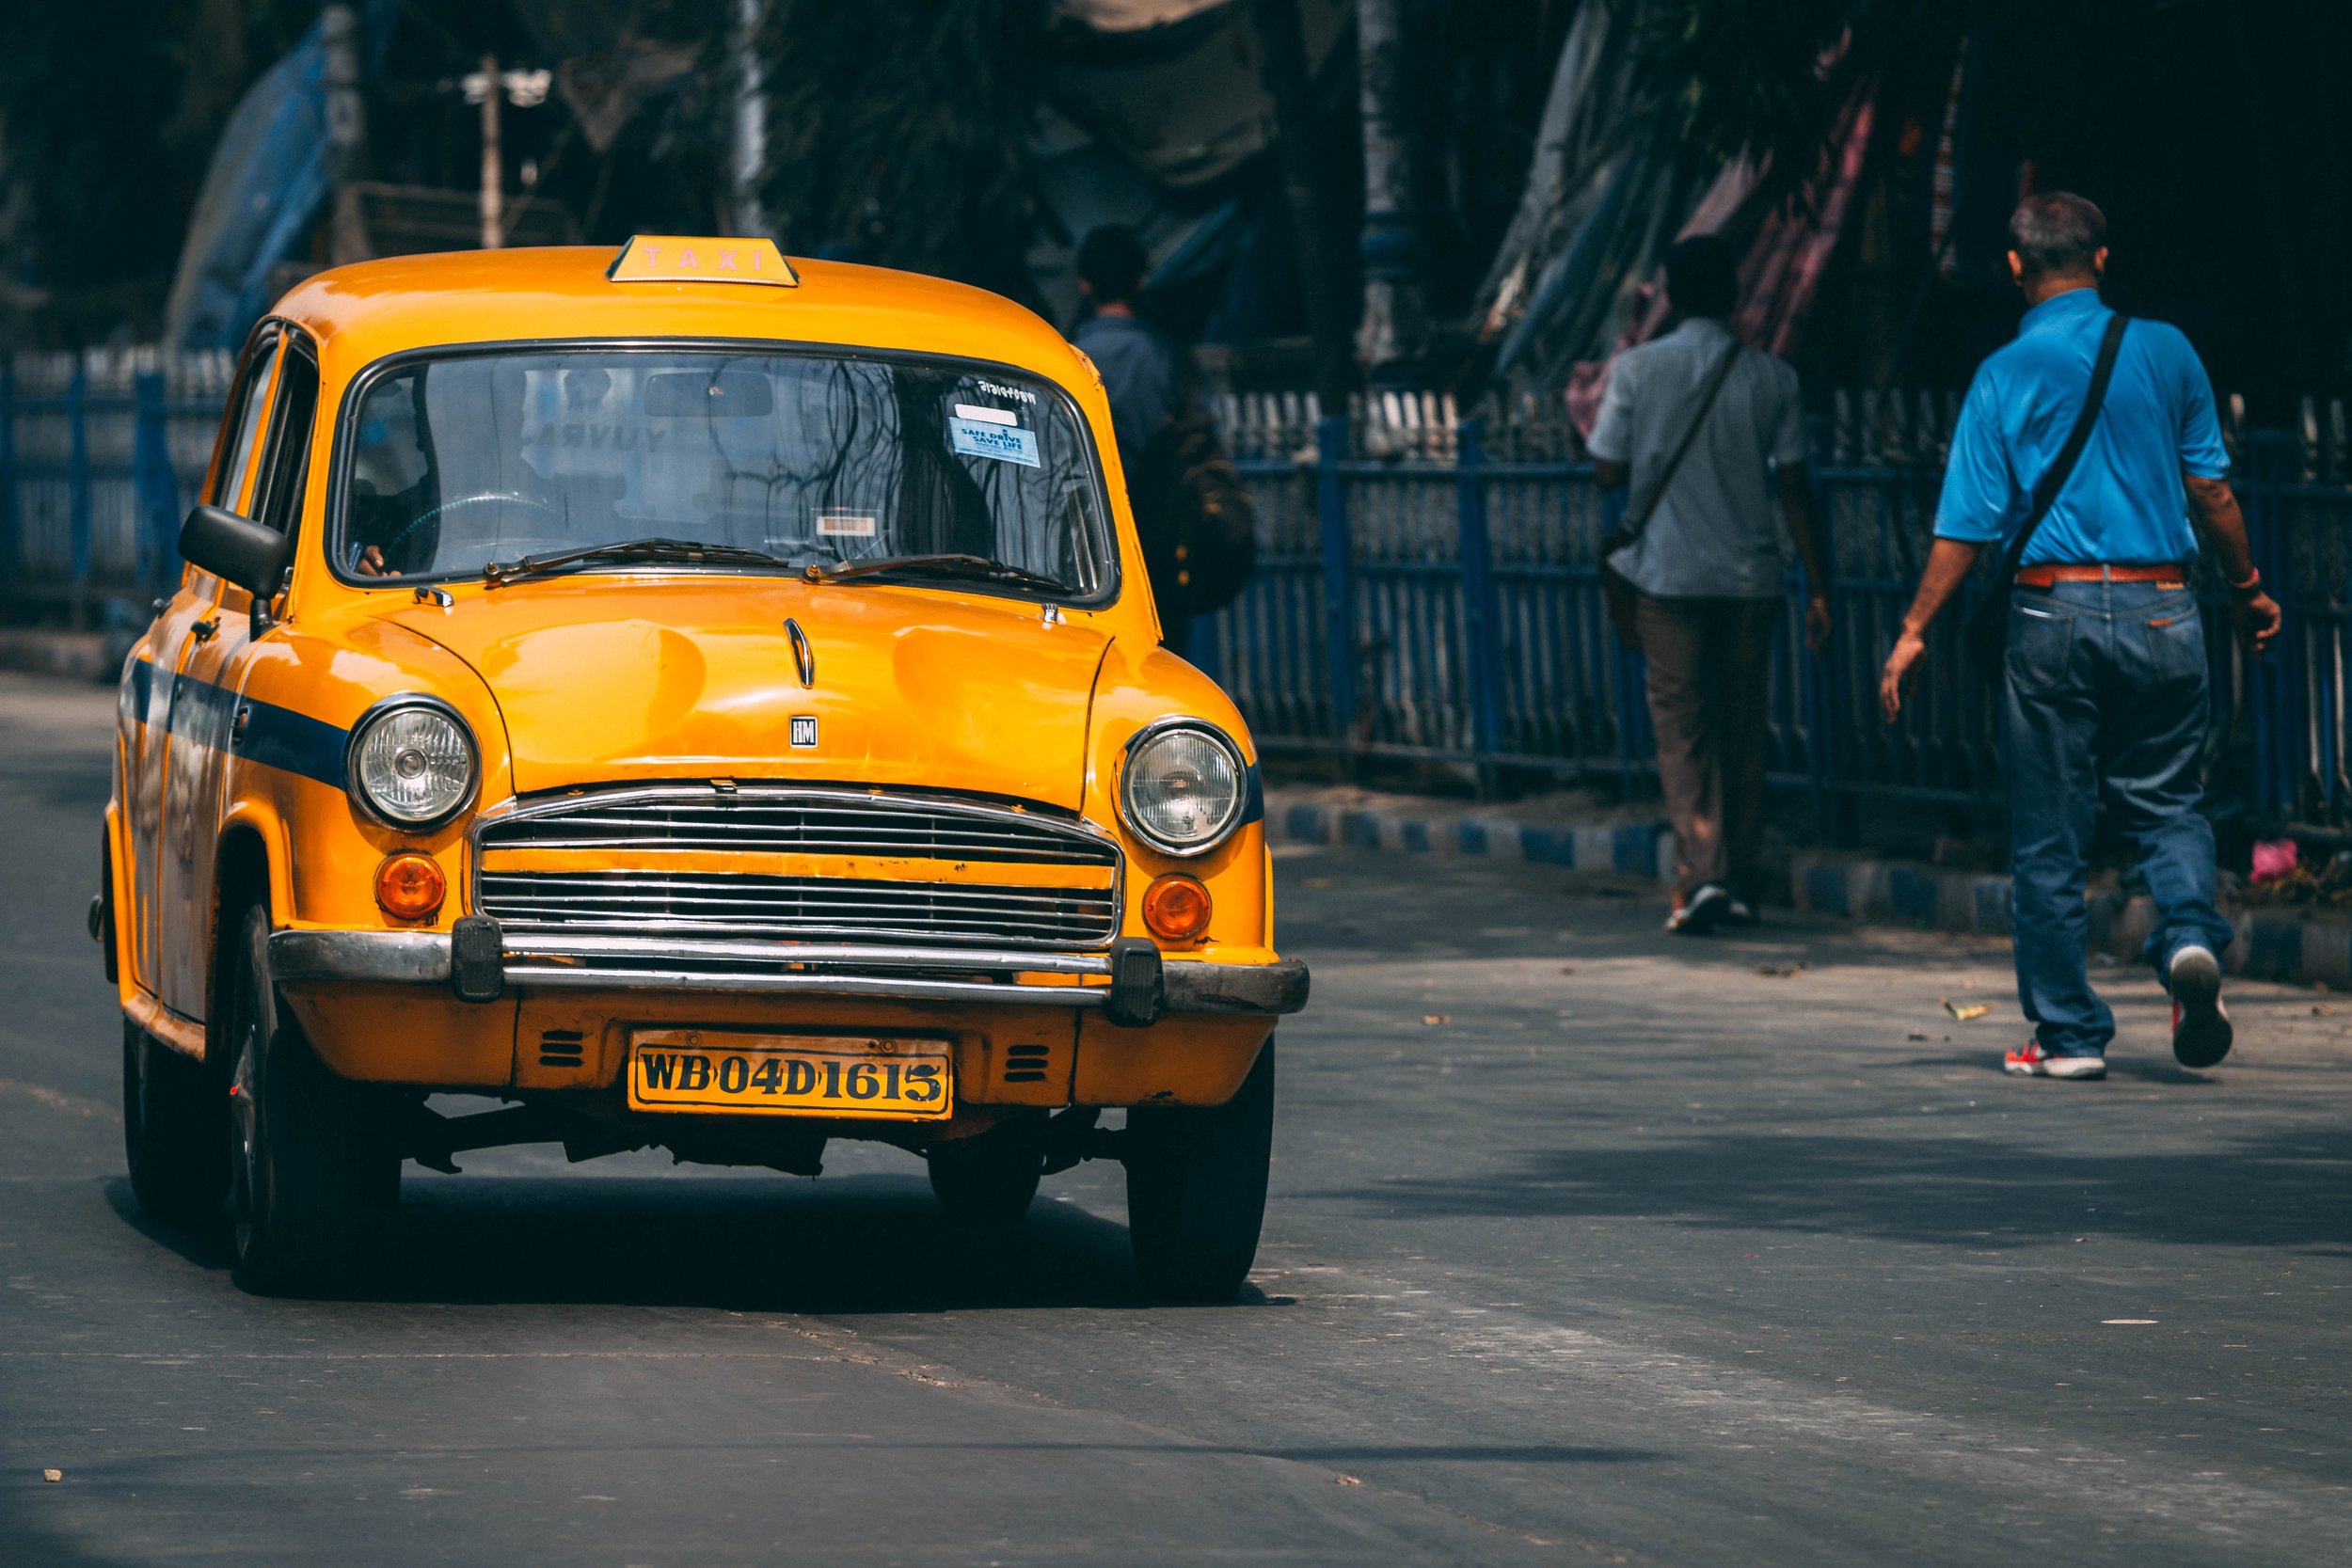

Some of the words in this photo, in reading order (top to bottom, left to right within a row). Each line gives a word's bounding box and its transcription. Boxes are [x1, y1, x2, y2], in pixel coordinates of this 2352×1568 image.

[642, 246, 762, 271] TAXI
[961, 428, 985, 437] SAFE
[990, 430, 1022, 444] DRIVE
[973, 436, 999, 446] SAVE
[1003, 440, 1023, 451] LIFE
[792, 721, 815, 743] HM
[640, 1053, 943, 1102] WB04D1615
